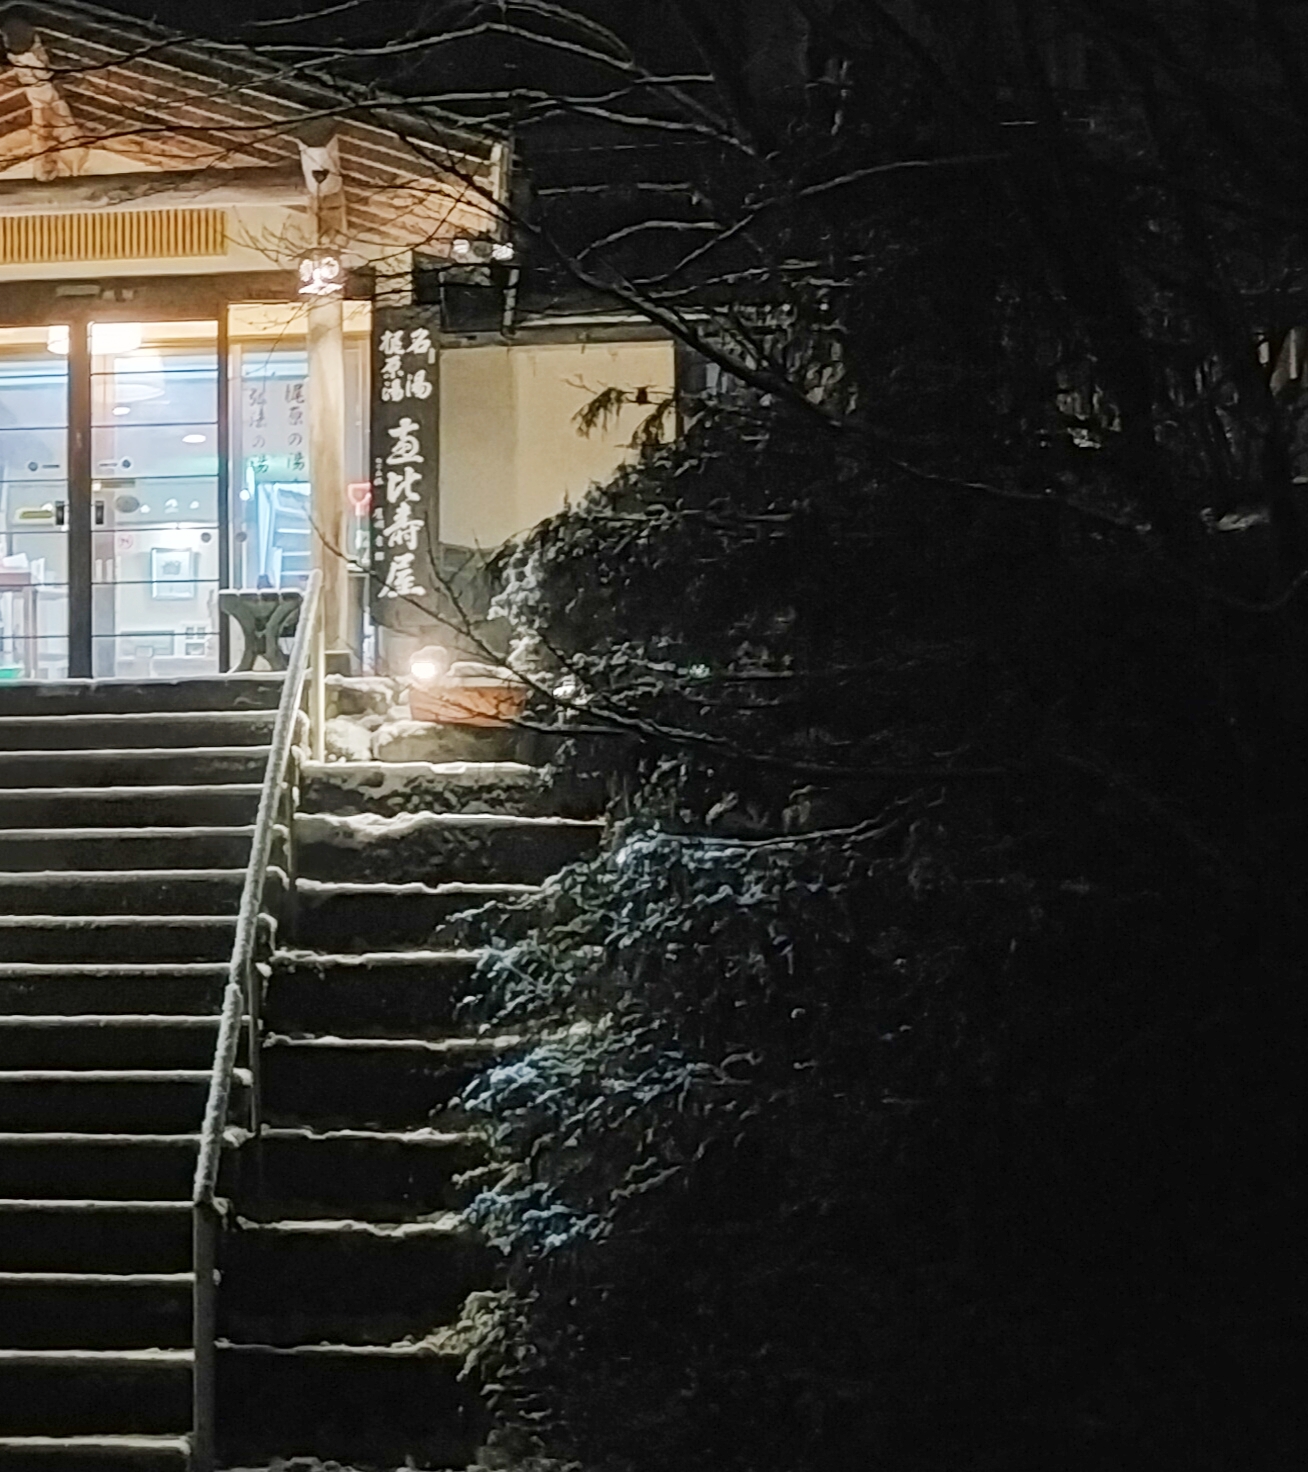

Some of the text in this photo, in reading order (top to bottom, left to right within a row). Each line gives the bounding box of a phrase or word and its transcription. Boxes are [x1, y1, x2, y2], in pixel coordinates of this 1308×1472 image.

[378, 329, 405, 402] 梶原湯
[405, 328, 432, 399] 名湯
